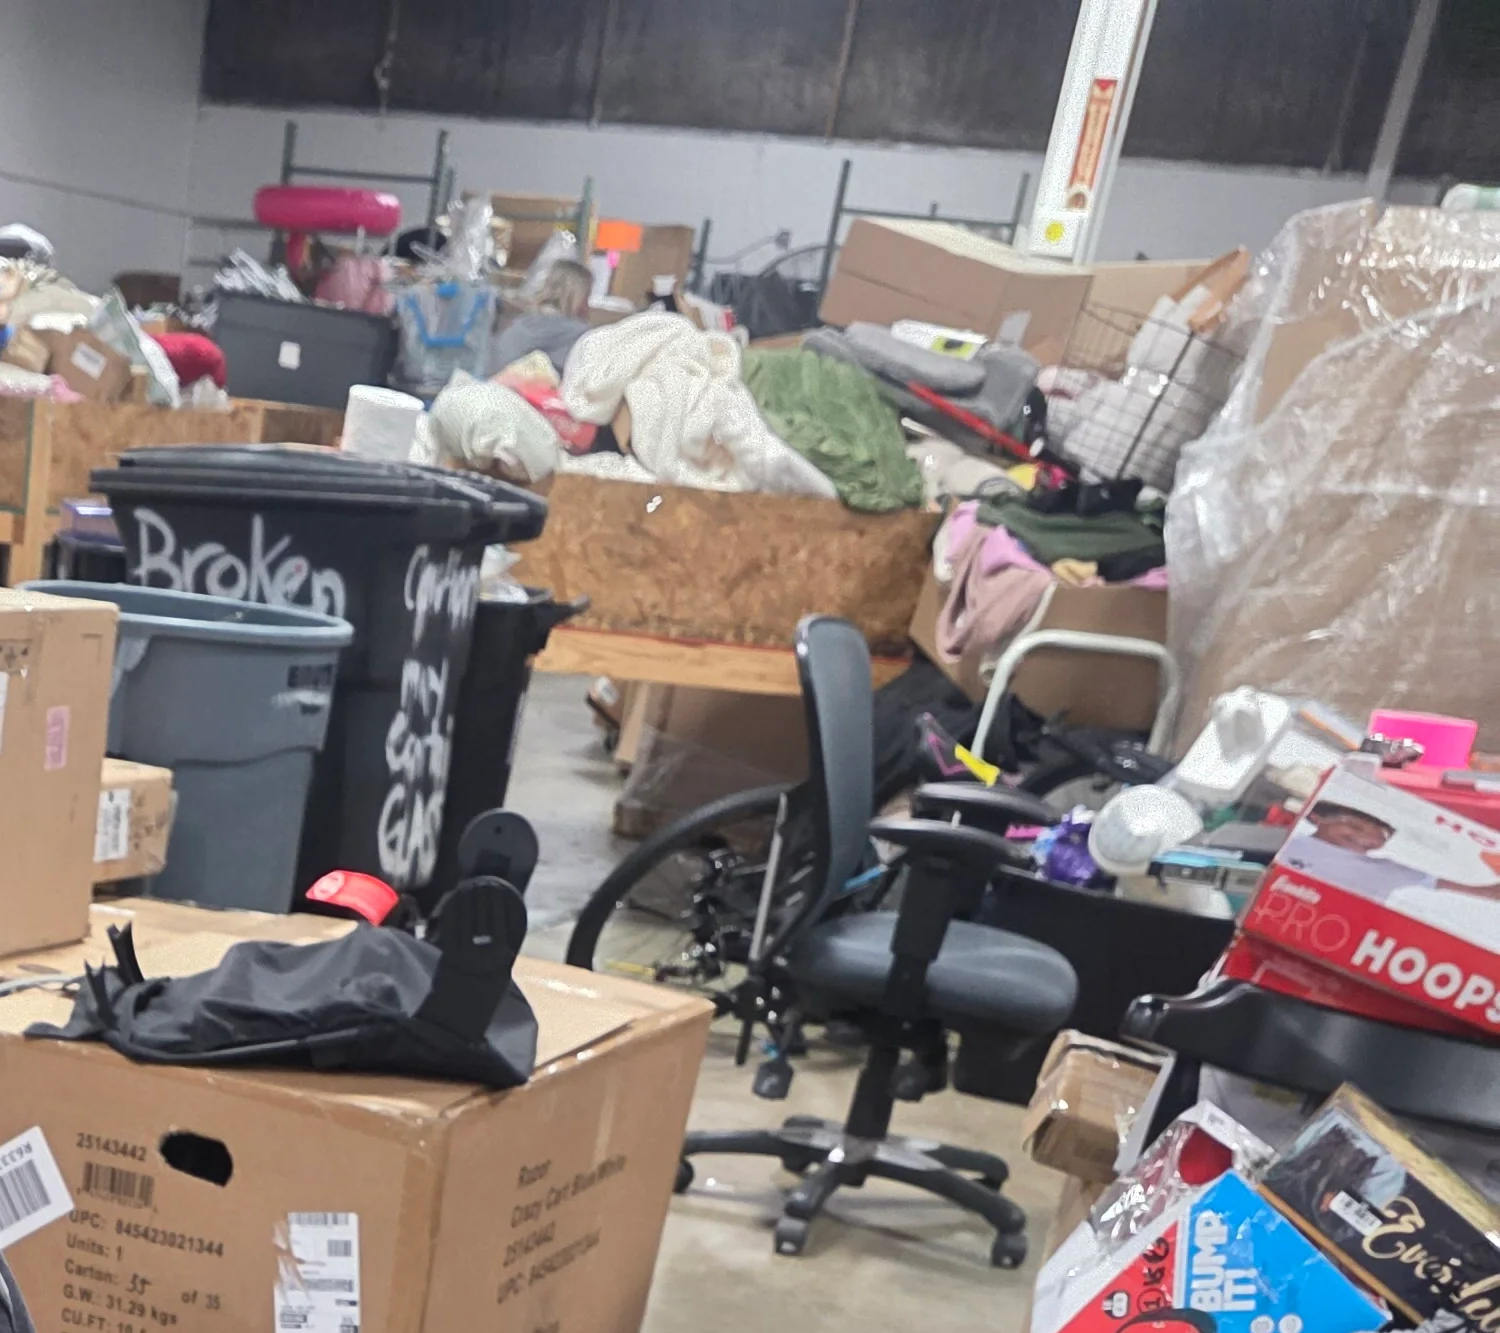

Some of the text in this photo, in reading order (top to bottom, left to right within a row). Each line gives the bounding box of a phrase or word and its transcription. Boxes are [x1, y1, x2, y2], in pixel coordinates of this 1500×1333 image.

[133, 507, 346, 618] Broken
[1253, 893, 1351, 953] PRO
[76, 1132, 148, 1162] 25143442
[66, 1233, 125, 1261] Units: 1
[115, 1219, 225, 1259] 845423021344
[1189, 1209, 1230, 1312] BUMP
[64, 1259, 119, 1286] Carton:
[181, 1289, 199, 1305] of
[1224, 1267, 1258, 1311] IT!
[151, 1305, 178, 1327] kgs
